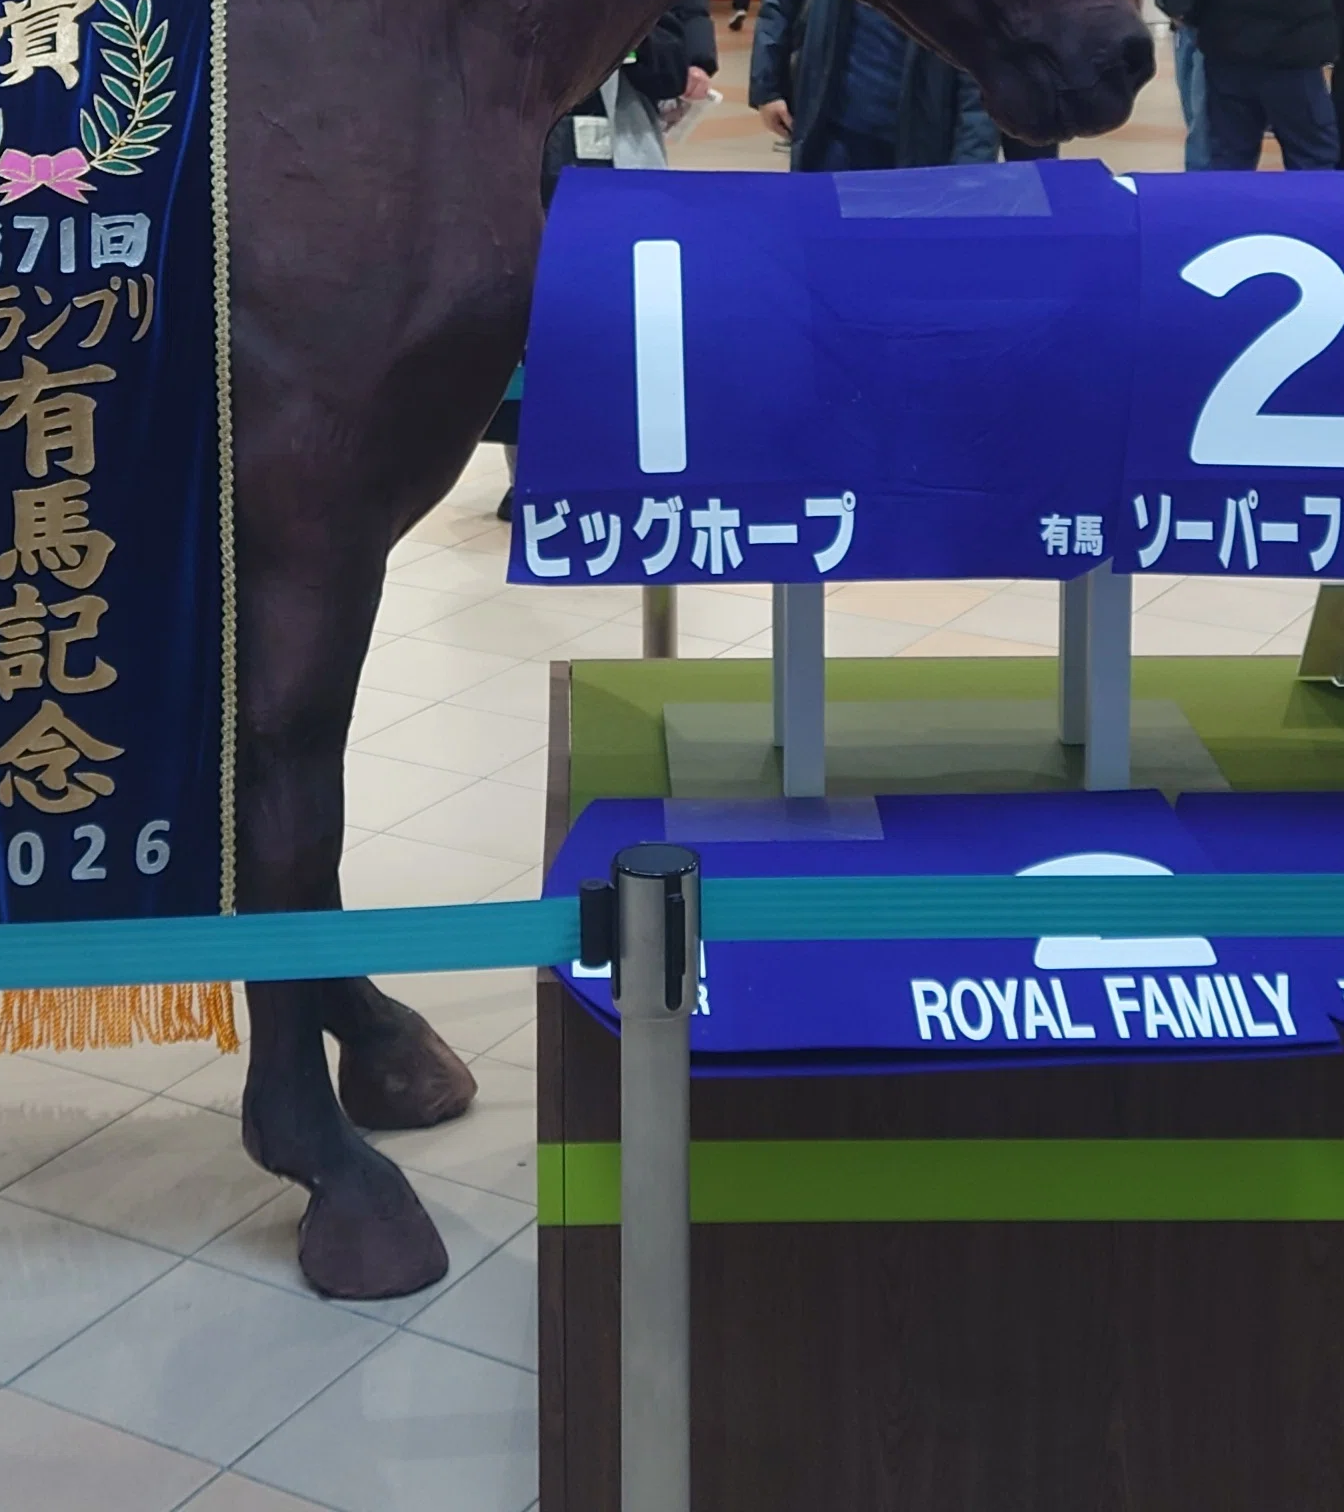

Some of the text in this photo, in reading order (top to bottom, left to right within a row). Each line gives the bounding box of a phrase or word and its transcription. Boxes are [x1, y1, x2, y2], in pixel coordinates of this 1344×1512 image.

[633, 240, 687, 473] 1
[522, 490, 857, 577] ビッグホープ
[1040, 513, 1104, 557] 有馬
[910, 972, 1299, 1041] ROYAL FAMILY
